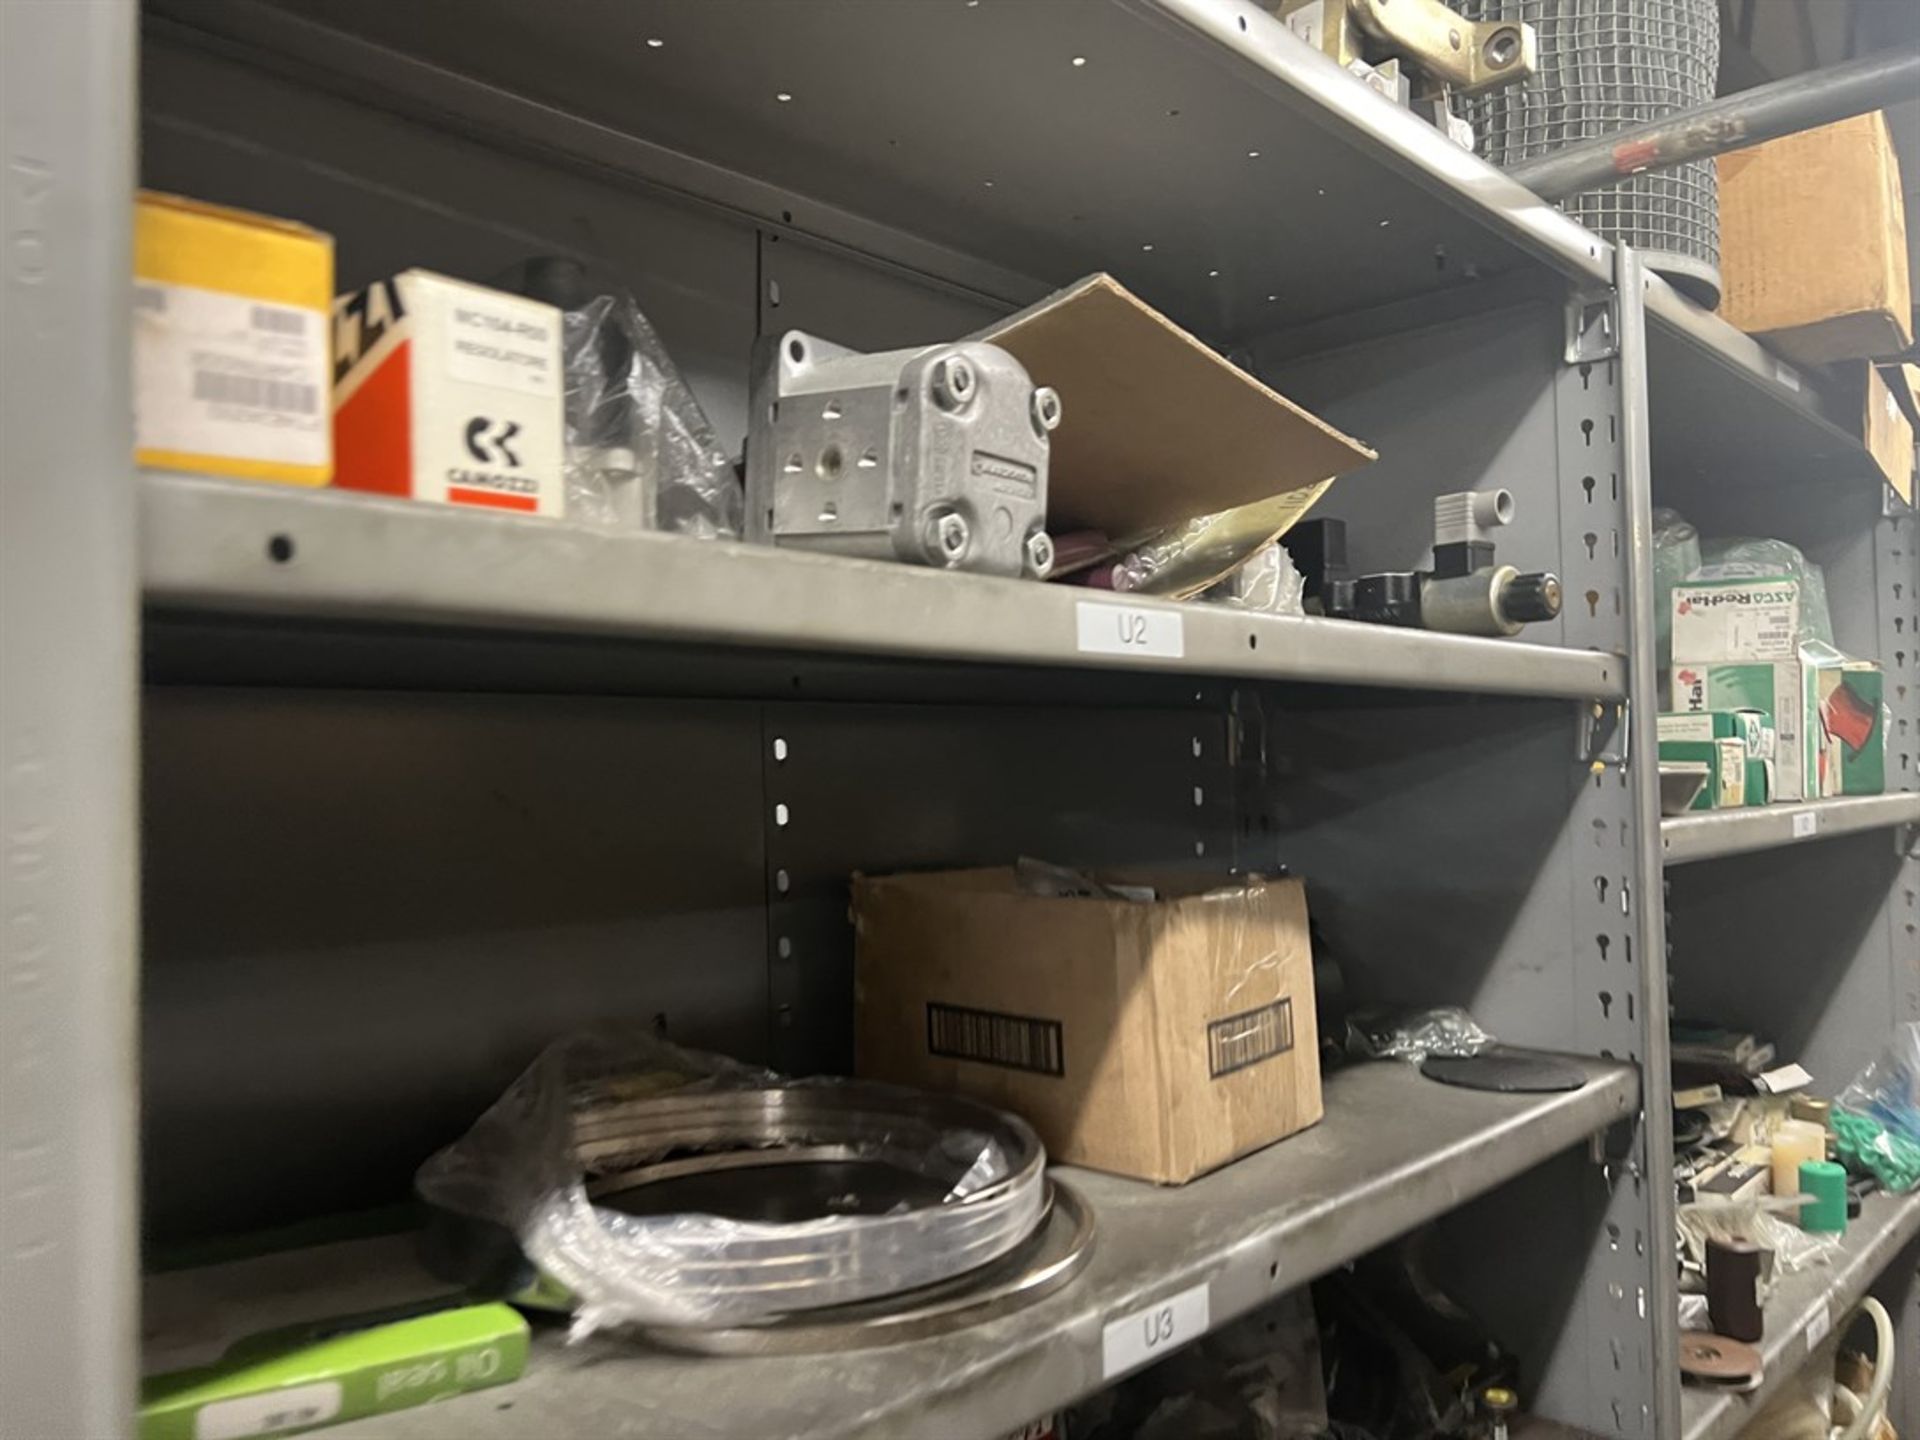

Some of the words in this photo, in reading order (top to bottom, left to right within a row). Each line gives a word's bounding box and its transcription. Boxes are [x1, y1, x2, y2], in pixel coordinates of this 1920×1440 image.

[447, 468, 538, 493] CAMOZZI
[1117, 613, 1147, 645] U2
[1143, 1306, 1174, 1348] U3
